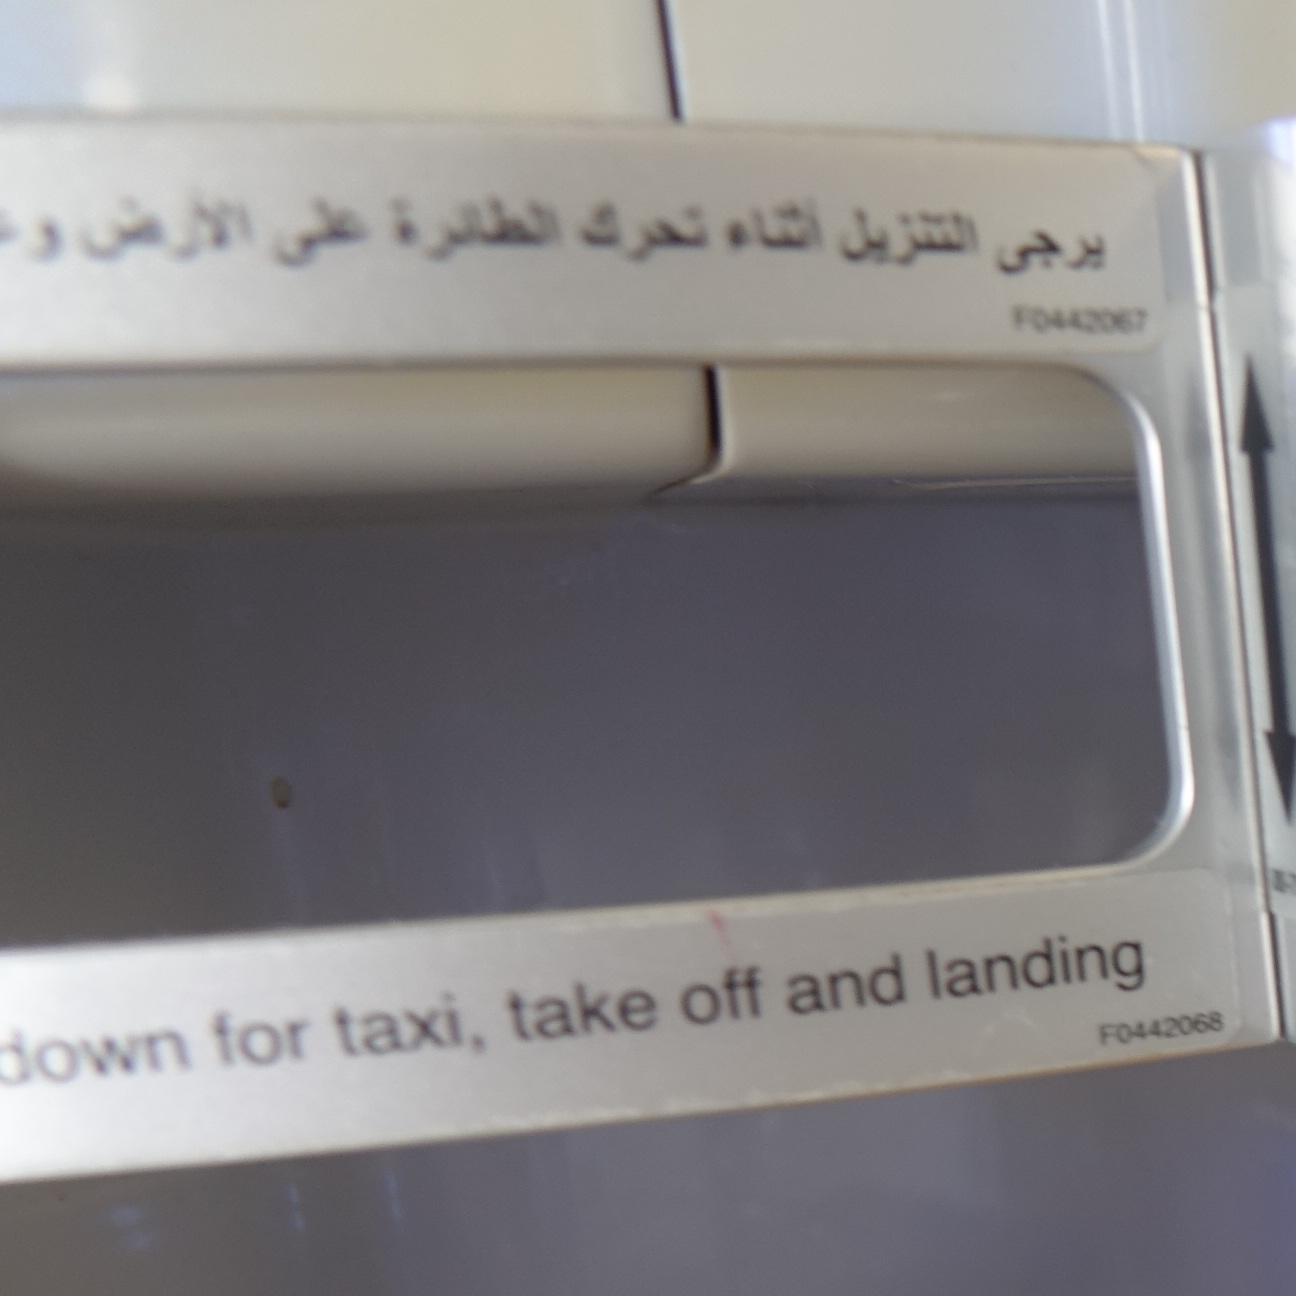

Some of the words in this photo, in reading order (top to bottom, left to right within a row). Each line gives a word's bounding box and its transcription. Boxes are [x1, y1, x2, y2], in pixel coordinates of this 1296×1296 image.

[0, 1027, 194, 1085] down
[209, 1009, 311, 1069] for
[333, 990, 487, 1058] taxi,
[506, 978, 658, 1042] take
[680, 964, 762, 1026] off
[786, 953, 907, 1016] and
[924, 935, 1146, 1000] landing
